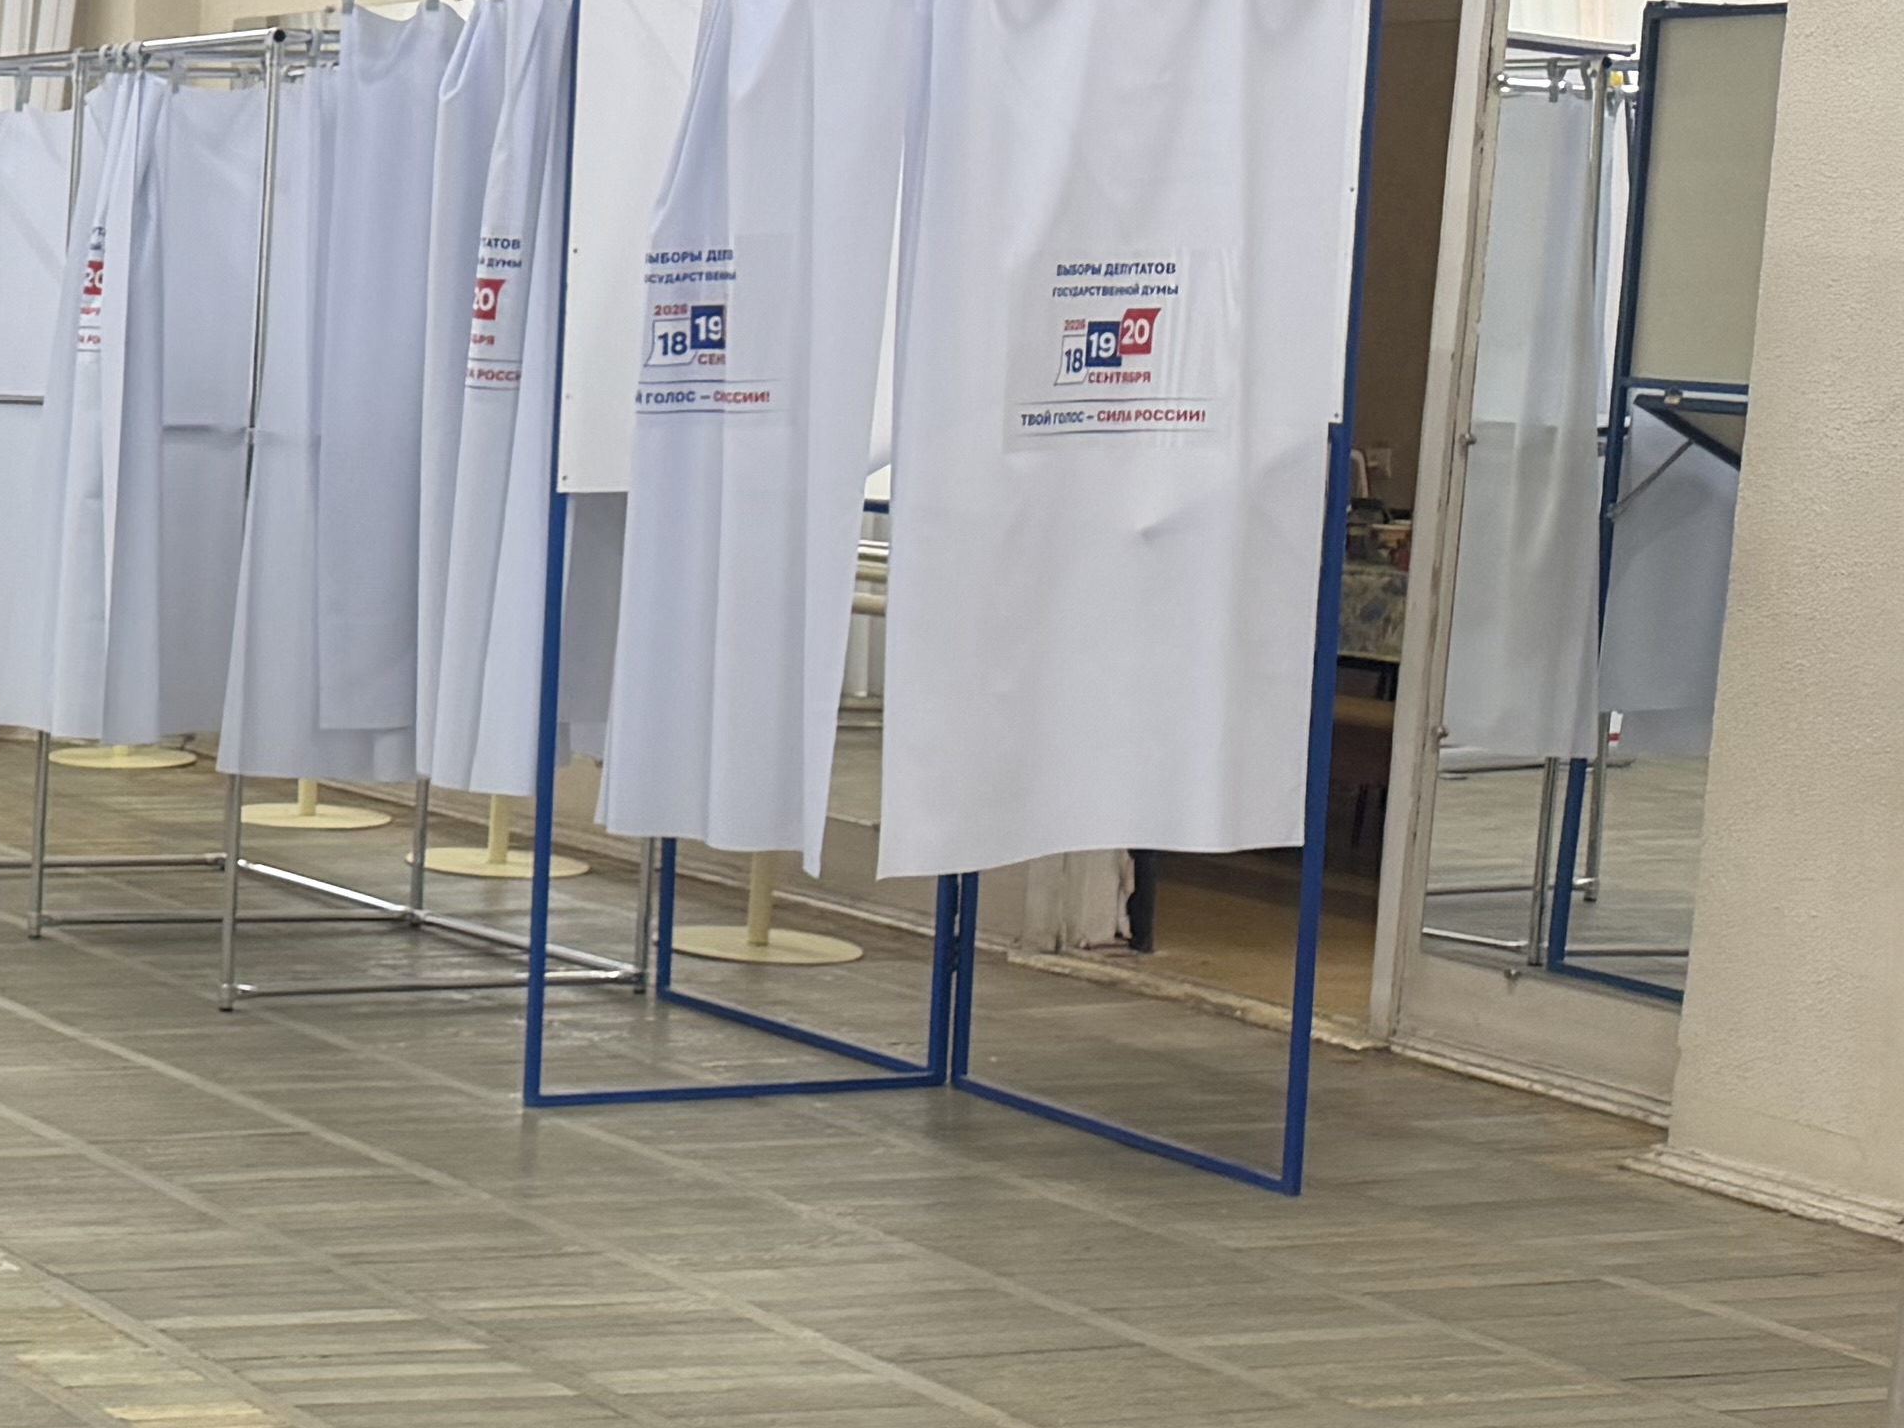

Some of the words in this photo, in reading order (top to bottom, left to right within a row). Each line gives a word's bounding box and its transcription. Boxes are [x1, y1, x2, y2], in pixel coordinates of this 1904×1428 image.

[1056, 263, 1101, 276] ВЫБОРЫ
[1104, 262, 1176, 276] ДЕПУТАТОВ
[1052, 283, 1139, 297] ГОСУДАРСТВЕННОЙ
[1141, 285, 1179, 297] ДУМЫ
[658, 331, 688, 356] 18
[694, 315, 722, 341] 19
[1121, 318, 1150, 345] 20
[1089, 331, 1117, 358] 19
[1064, 348, 1084, 373] 18
[1088, 371, 1151, 384] СЕНТЯБРЯ
[646, 391, 696, 404] ГОЛОС
[1021, 409, 1052, 426] ТВОЙ
[1053, 411, 1084, 424] ГОЛОС
[1097, 409, 1133, 423] СИЛА
[1135, 409, 1206, 422] РОССИИ!
